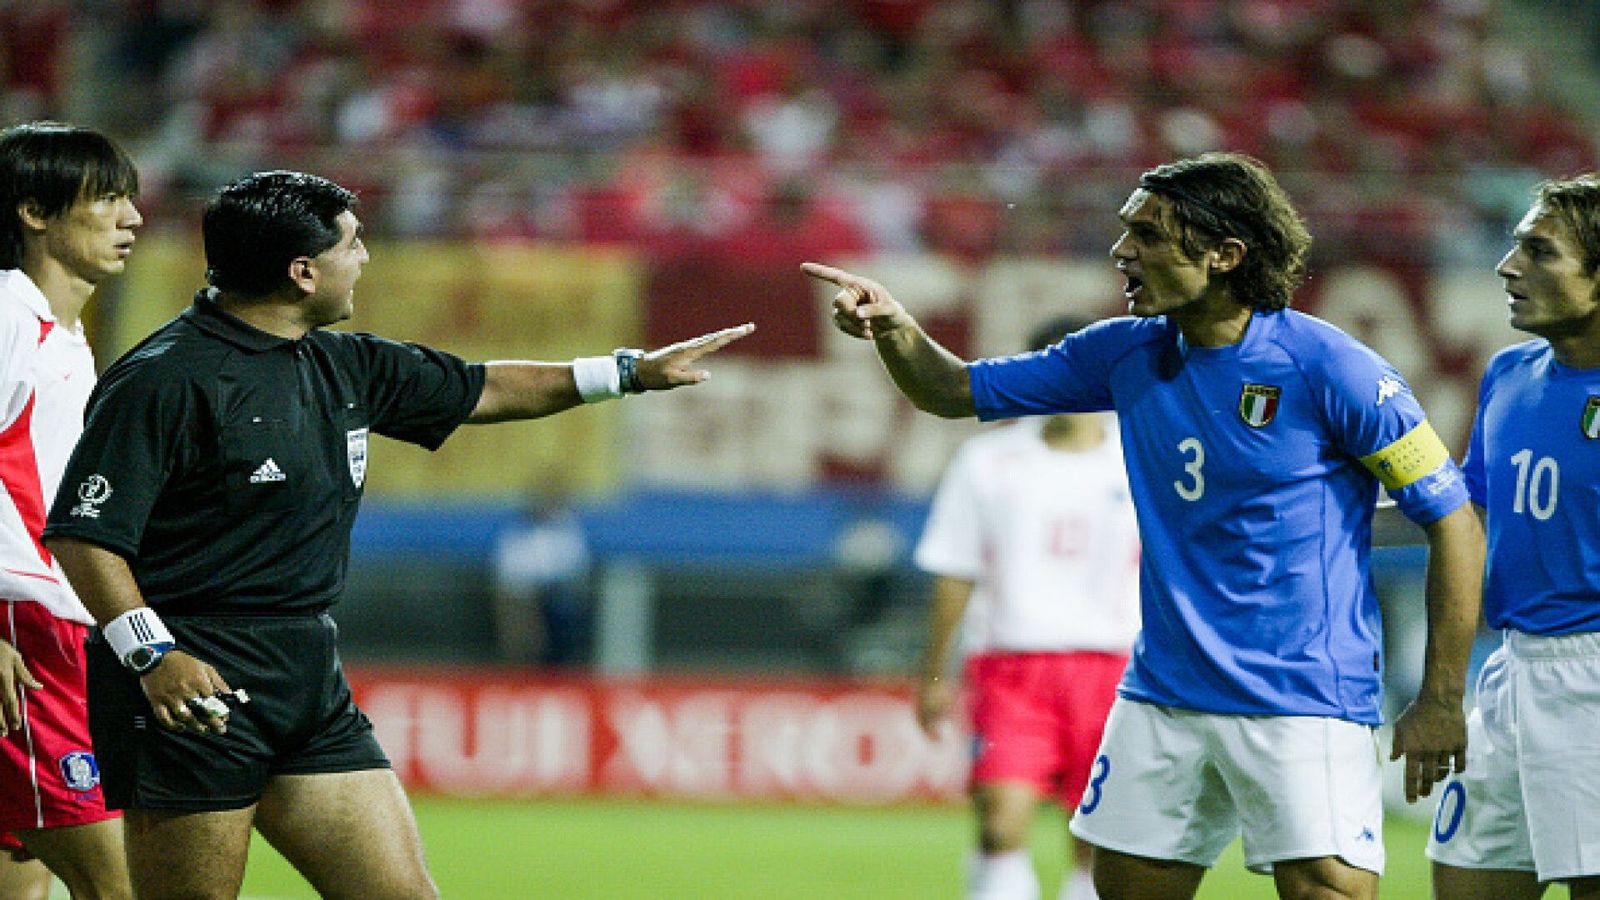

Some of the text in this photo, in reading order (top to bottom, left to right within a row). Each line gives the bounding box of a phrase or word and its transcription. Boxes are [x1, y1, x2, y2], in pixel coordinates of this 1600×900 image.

[1174, 437, 1205, 502] 3
[1510, 448, 1559, 521] 10
[1080, 754, 1111, 815] 3
